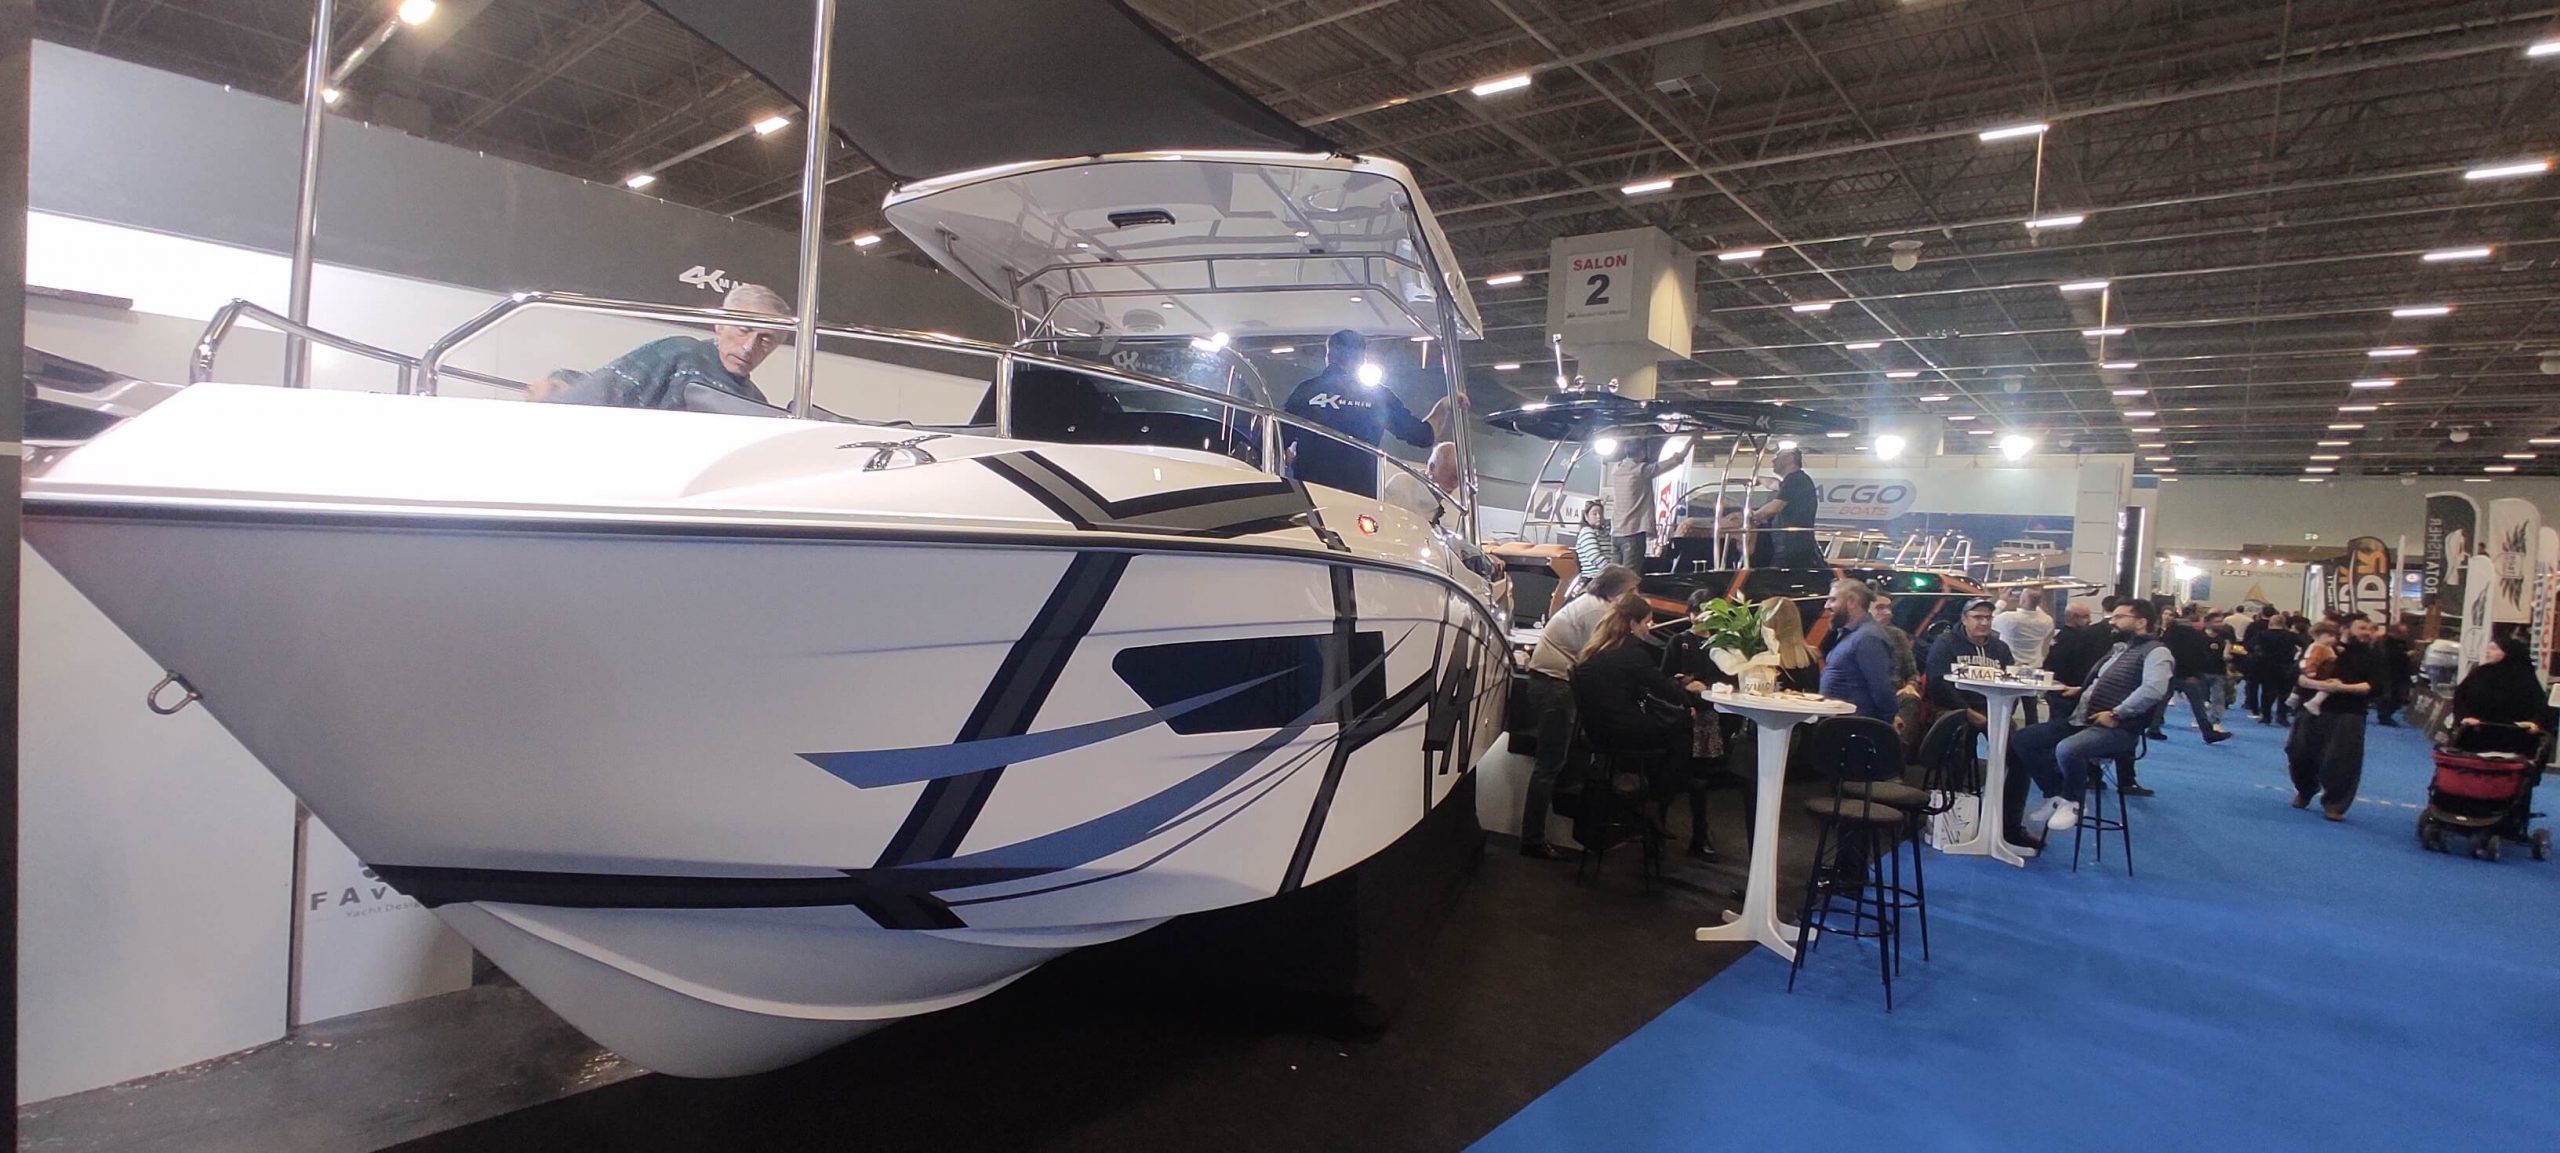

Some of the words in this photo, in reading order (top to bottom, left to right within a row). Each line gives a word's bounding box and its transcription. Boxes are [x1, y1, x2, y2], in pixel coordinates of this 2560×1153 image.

[1573, 255, 1627, 271] SALON
[679, 265, 726, 293] 4K
[1585, 274, 1610, 306] 2
[1309, 393, 1341, 410] 4K
[1839, 506, 1890, 516] BOATS
[310, 887, 387, 911] FAV
